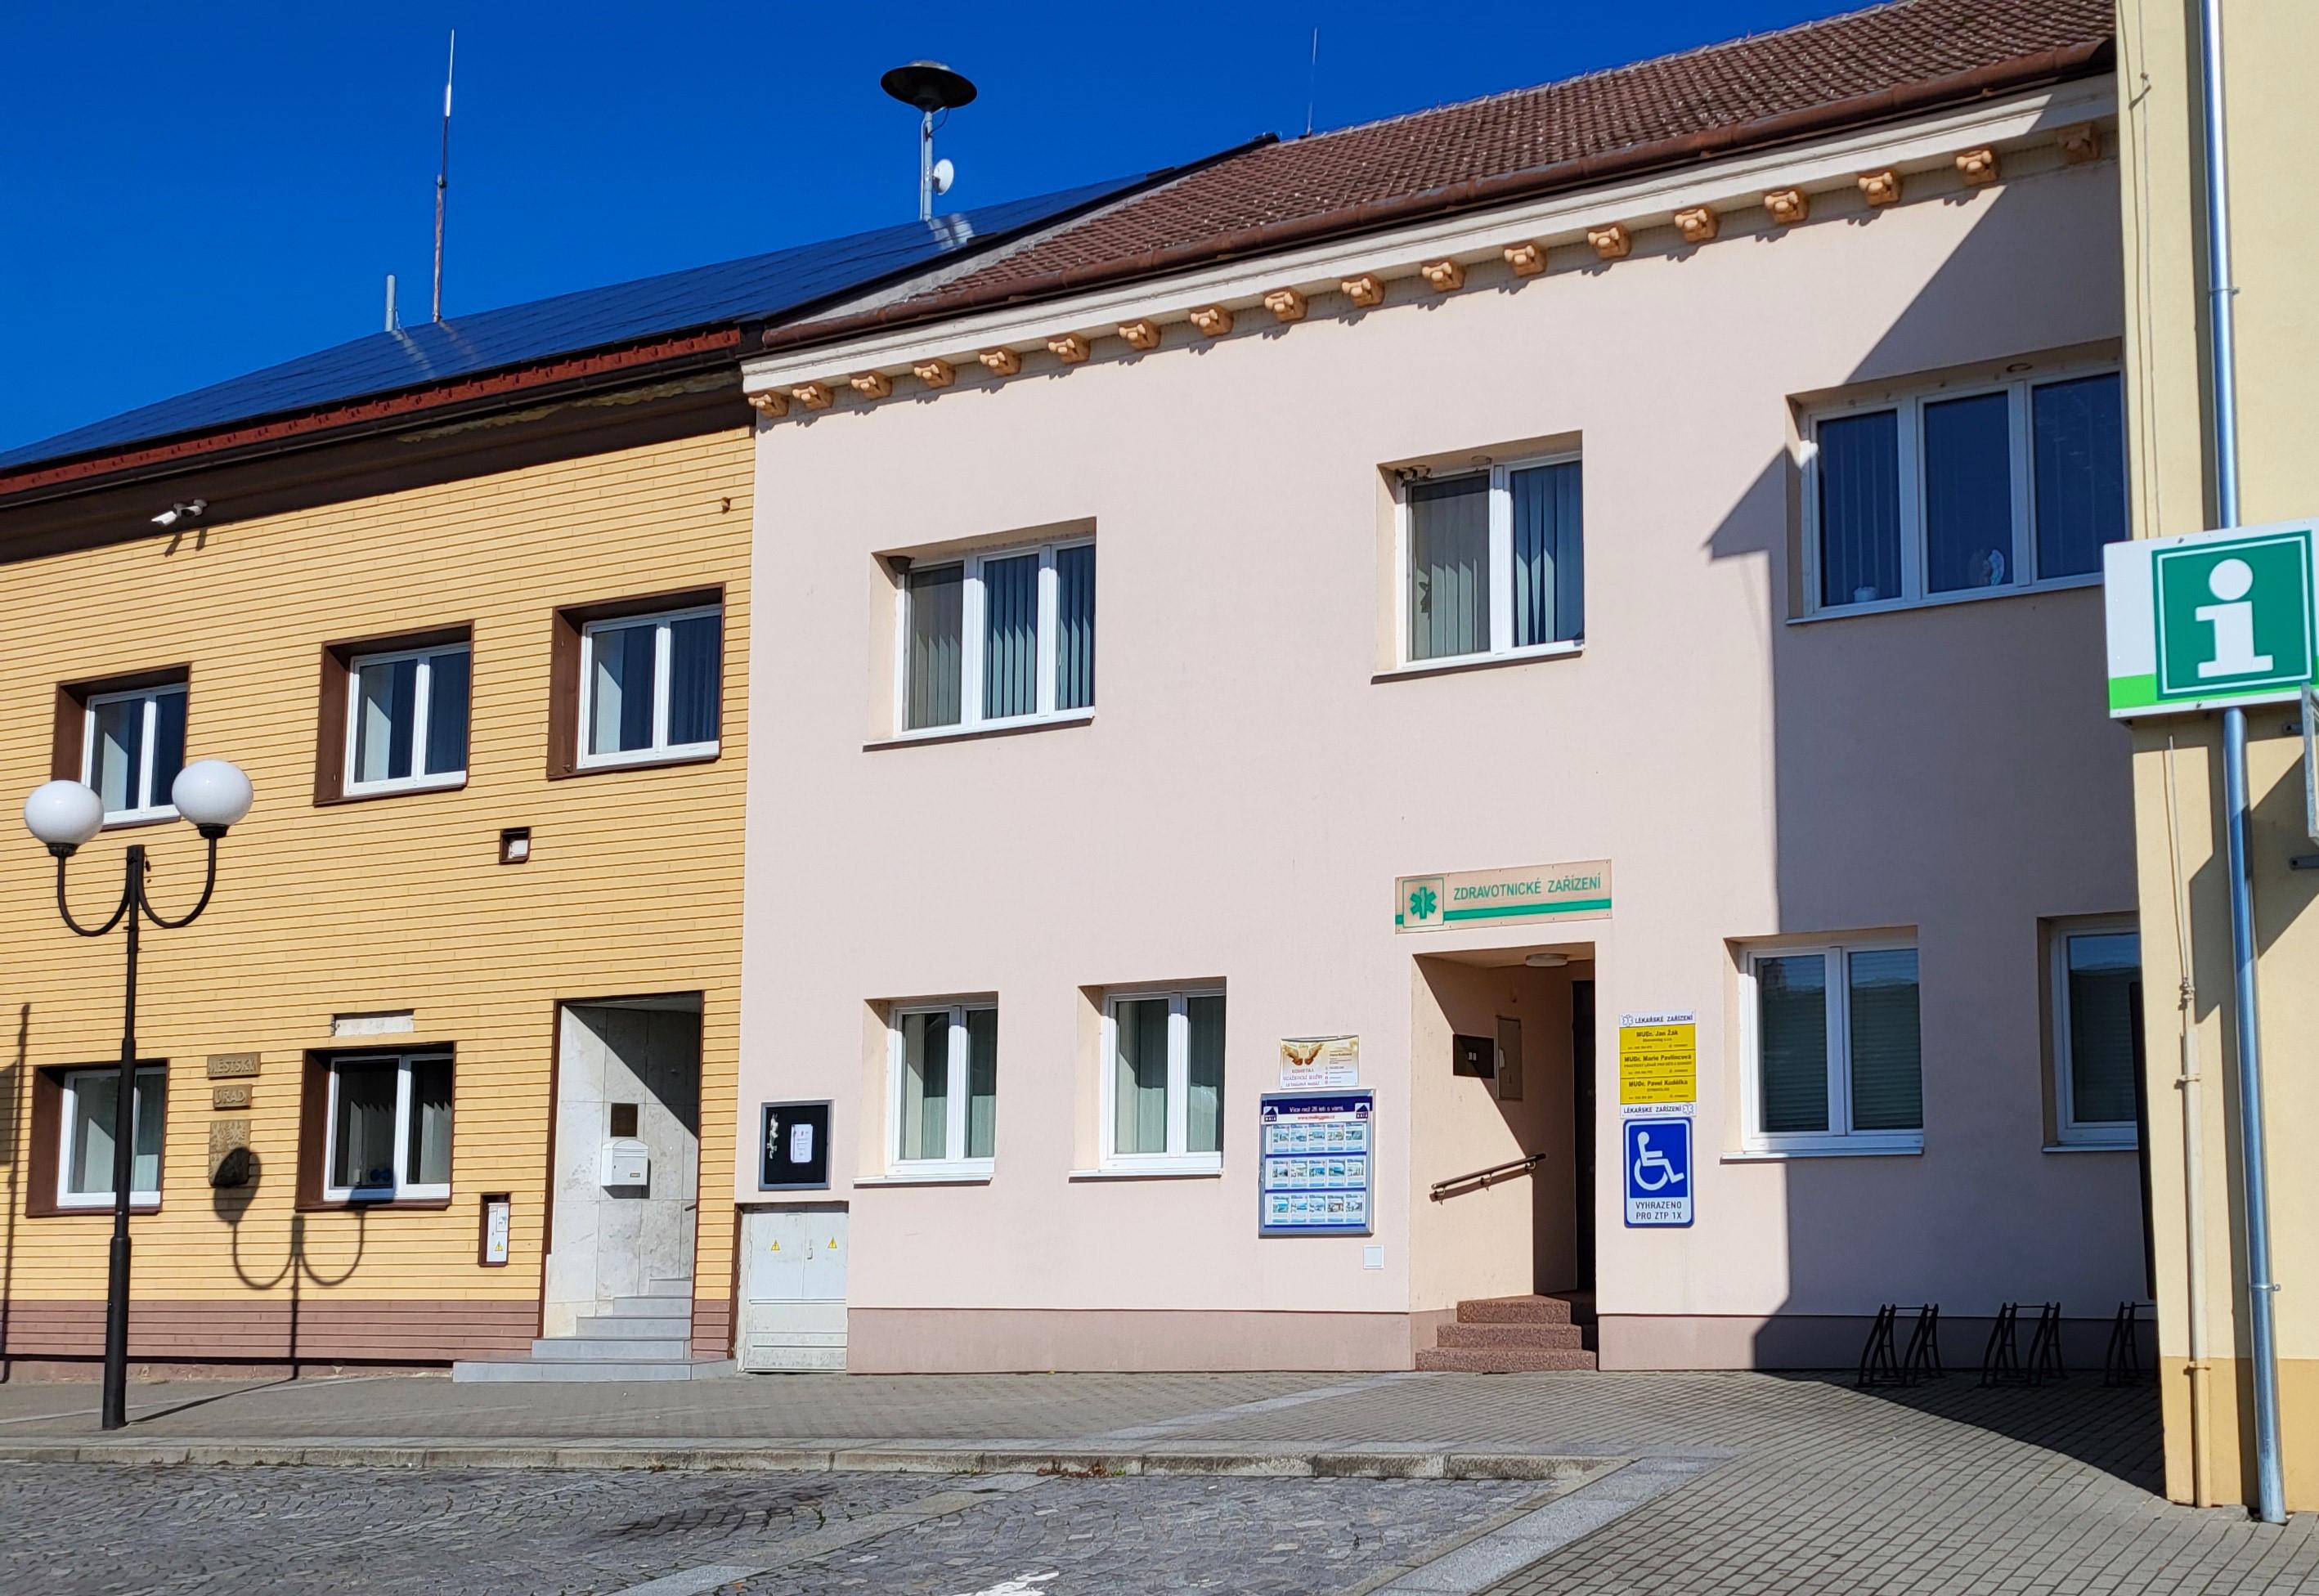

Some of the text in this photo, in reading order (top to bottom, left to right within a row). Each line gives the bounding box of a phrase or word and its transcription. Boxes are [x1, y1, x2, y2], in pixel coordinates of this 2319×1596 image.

[1453, 872, 1602, 901] ZDRAVOTNICKÉ ZAŘÍZENÍ
[1635, 1014, 1693, 1024] LÉKAŘSKÉ ZAŘÍZENÍ
[208, 1057, 256, 1074] MĚSTSKÝ
[215, 1088, 246, 1105] ÚŘAD
[1656, 1105, 1682, 1113] ZAŘÍZENÍ
[1635, 1200, 1682, 1209] VYHRAZENO
[1635, 1211, 1682, 1220] PRO ZTP 1X
